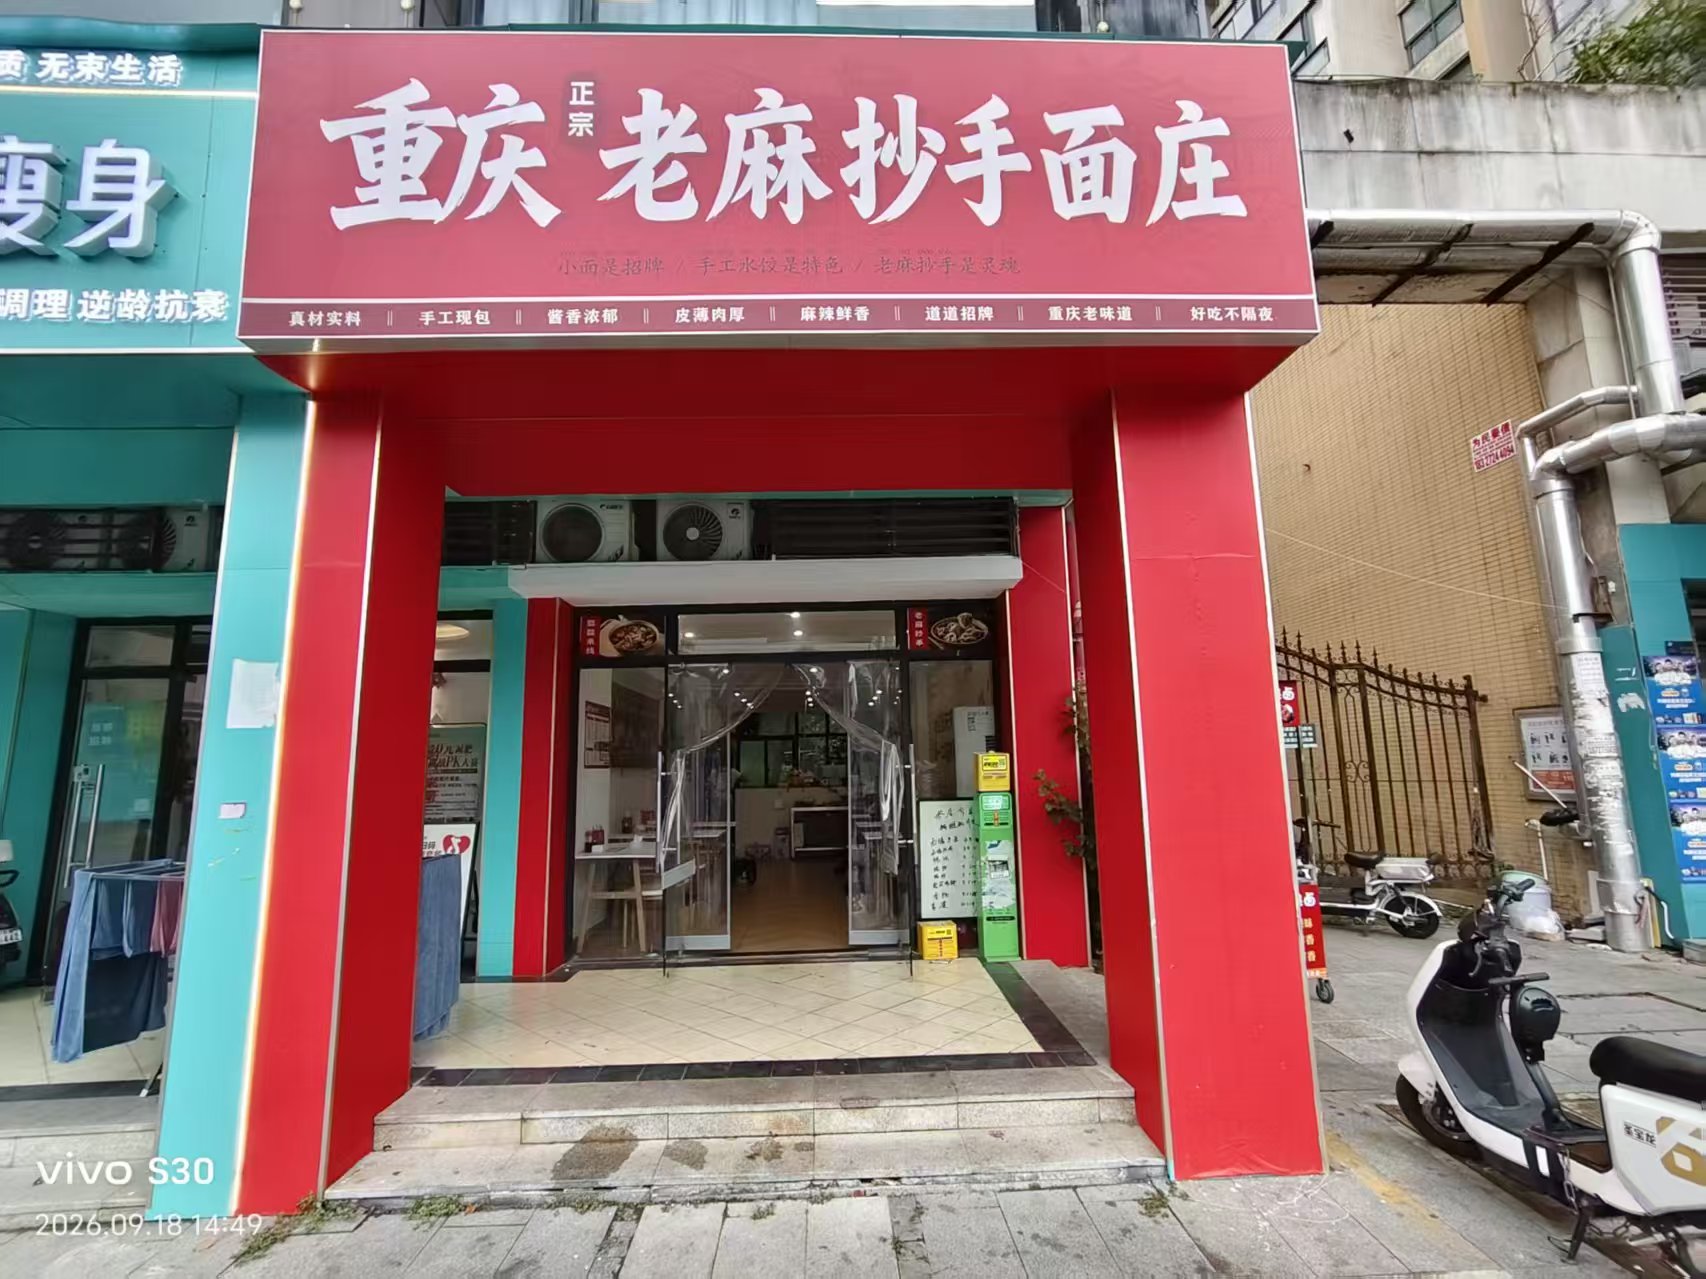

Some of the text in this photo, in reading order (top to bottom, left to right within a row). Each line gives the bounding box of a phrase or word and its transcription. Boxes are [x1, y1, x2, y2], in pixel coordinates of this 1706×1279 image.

[36, 51, 182, 84] 无束生活
[569, 82, 595, 137] 正宗
[321, 79, 1249, 231] 重庆 老麻抄手面庄
[558, 256, 665, 276] 小面是招牌
[0, 288, 227, 320] 调理 逆龄抗衰
[289, 306, 1274, 327] 真材实料 手工现包 酱香浓郁 皮薄肉厚 麻辣鲜香 道道招牌 重庆老味道 好吃不隔夜
